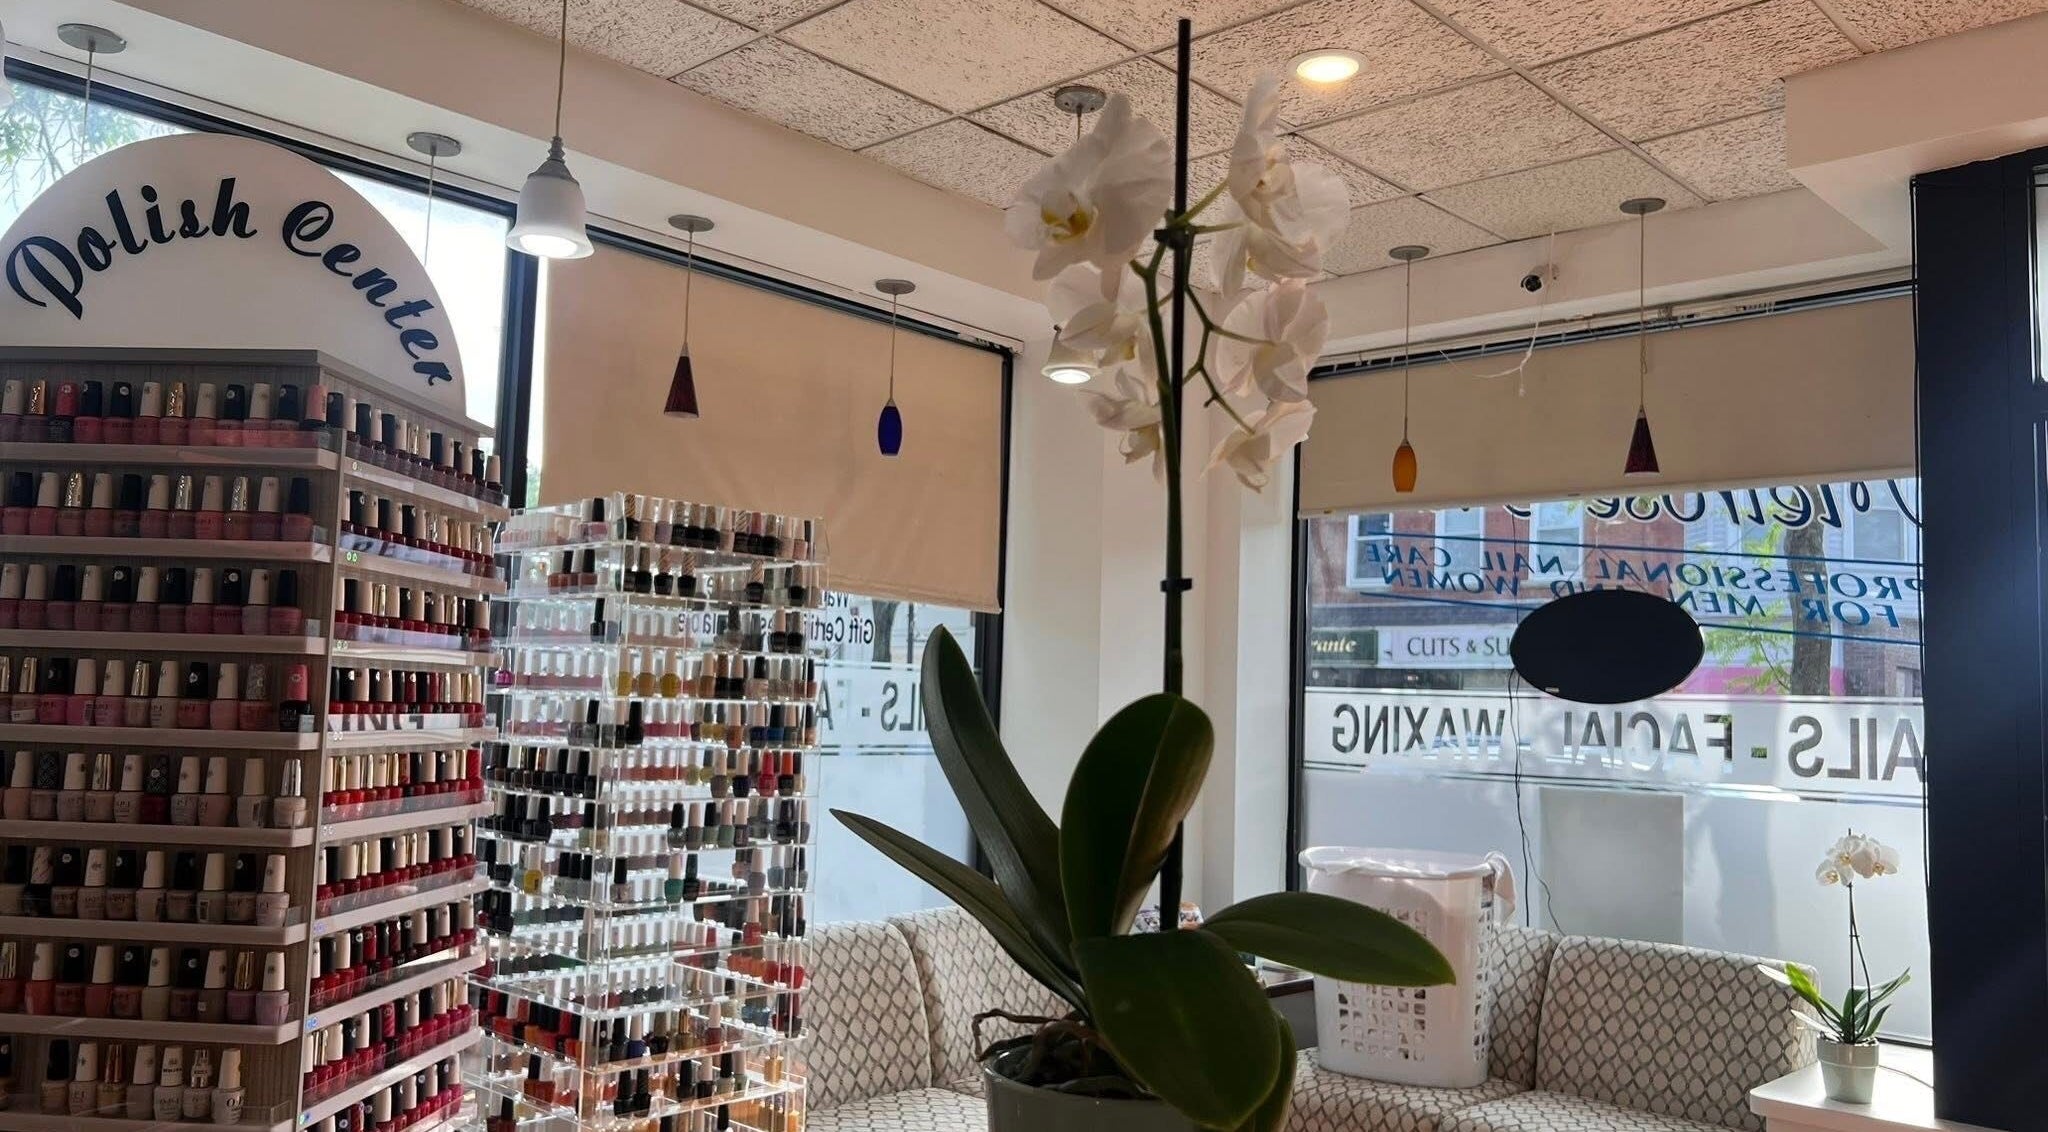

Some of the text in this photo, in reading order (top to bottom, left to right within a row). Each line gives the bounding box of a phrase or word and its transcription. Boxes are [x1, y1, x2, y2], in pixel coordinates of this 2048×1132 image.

[5, 177, 453, 387] Polish Center
[1312, 637, 1357, 654] rante
[1407, 636, 1511, 656] CUTS & SU
